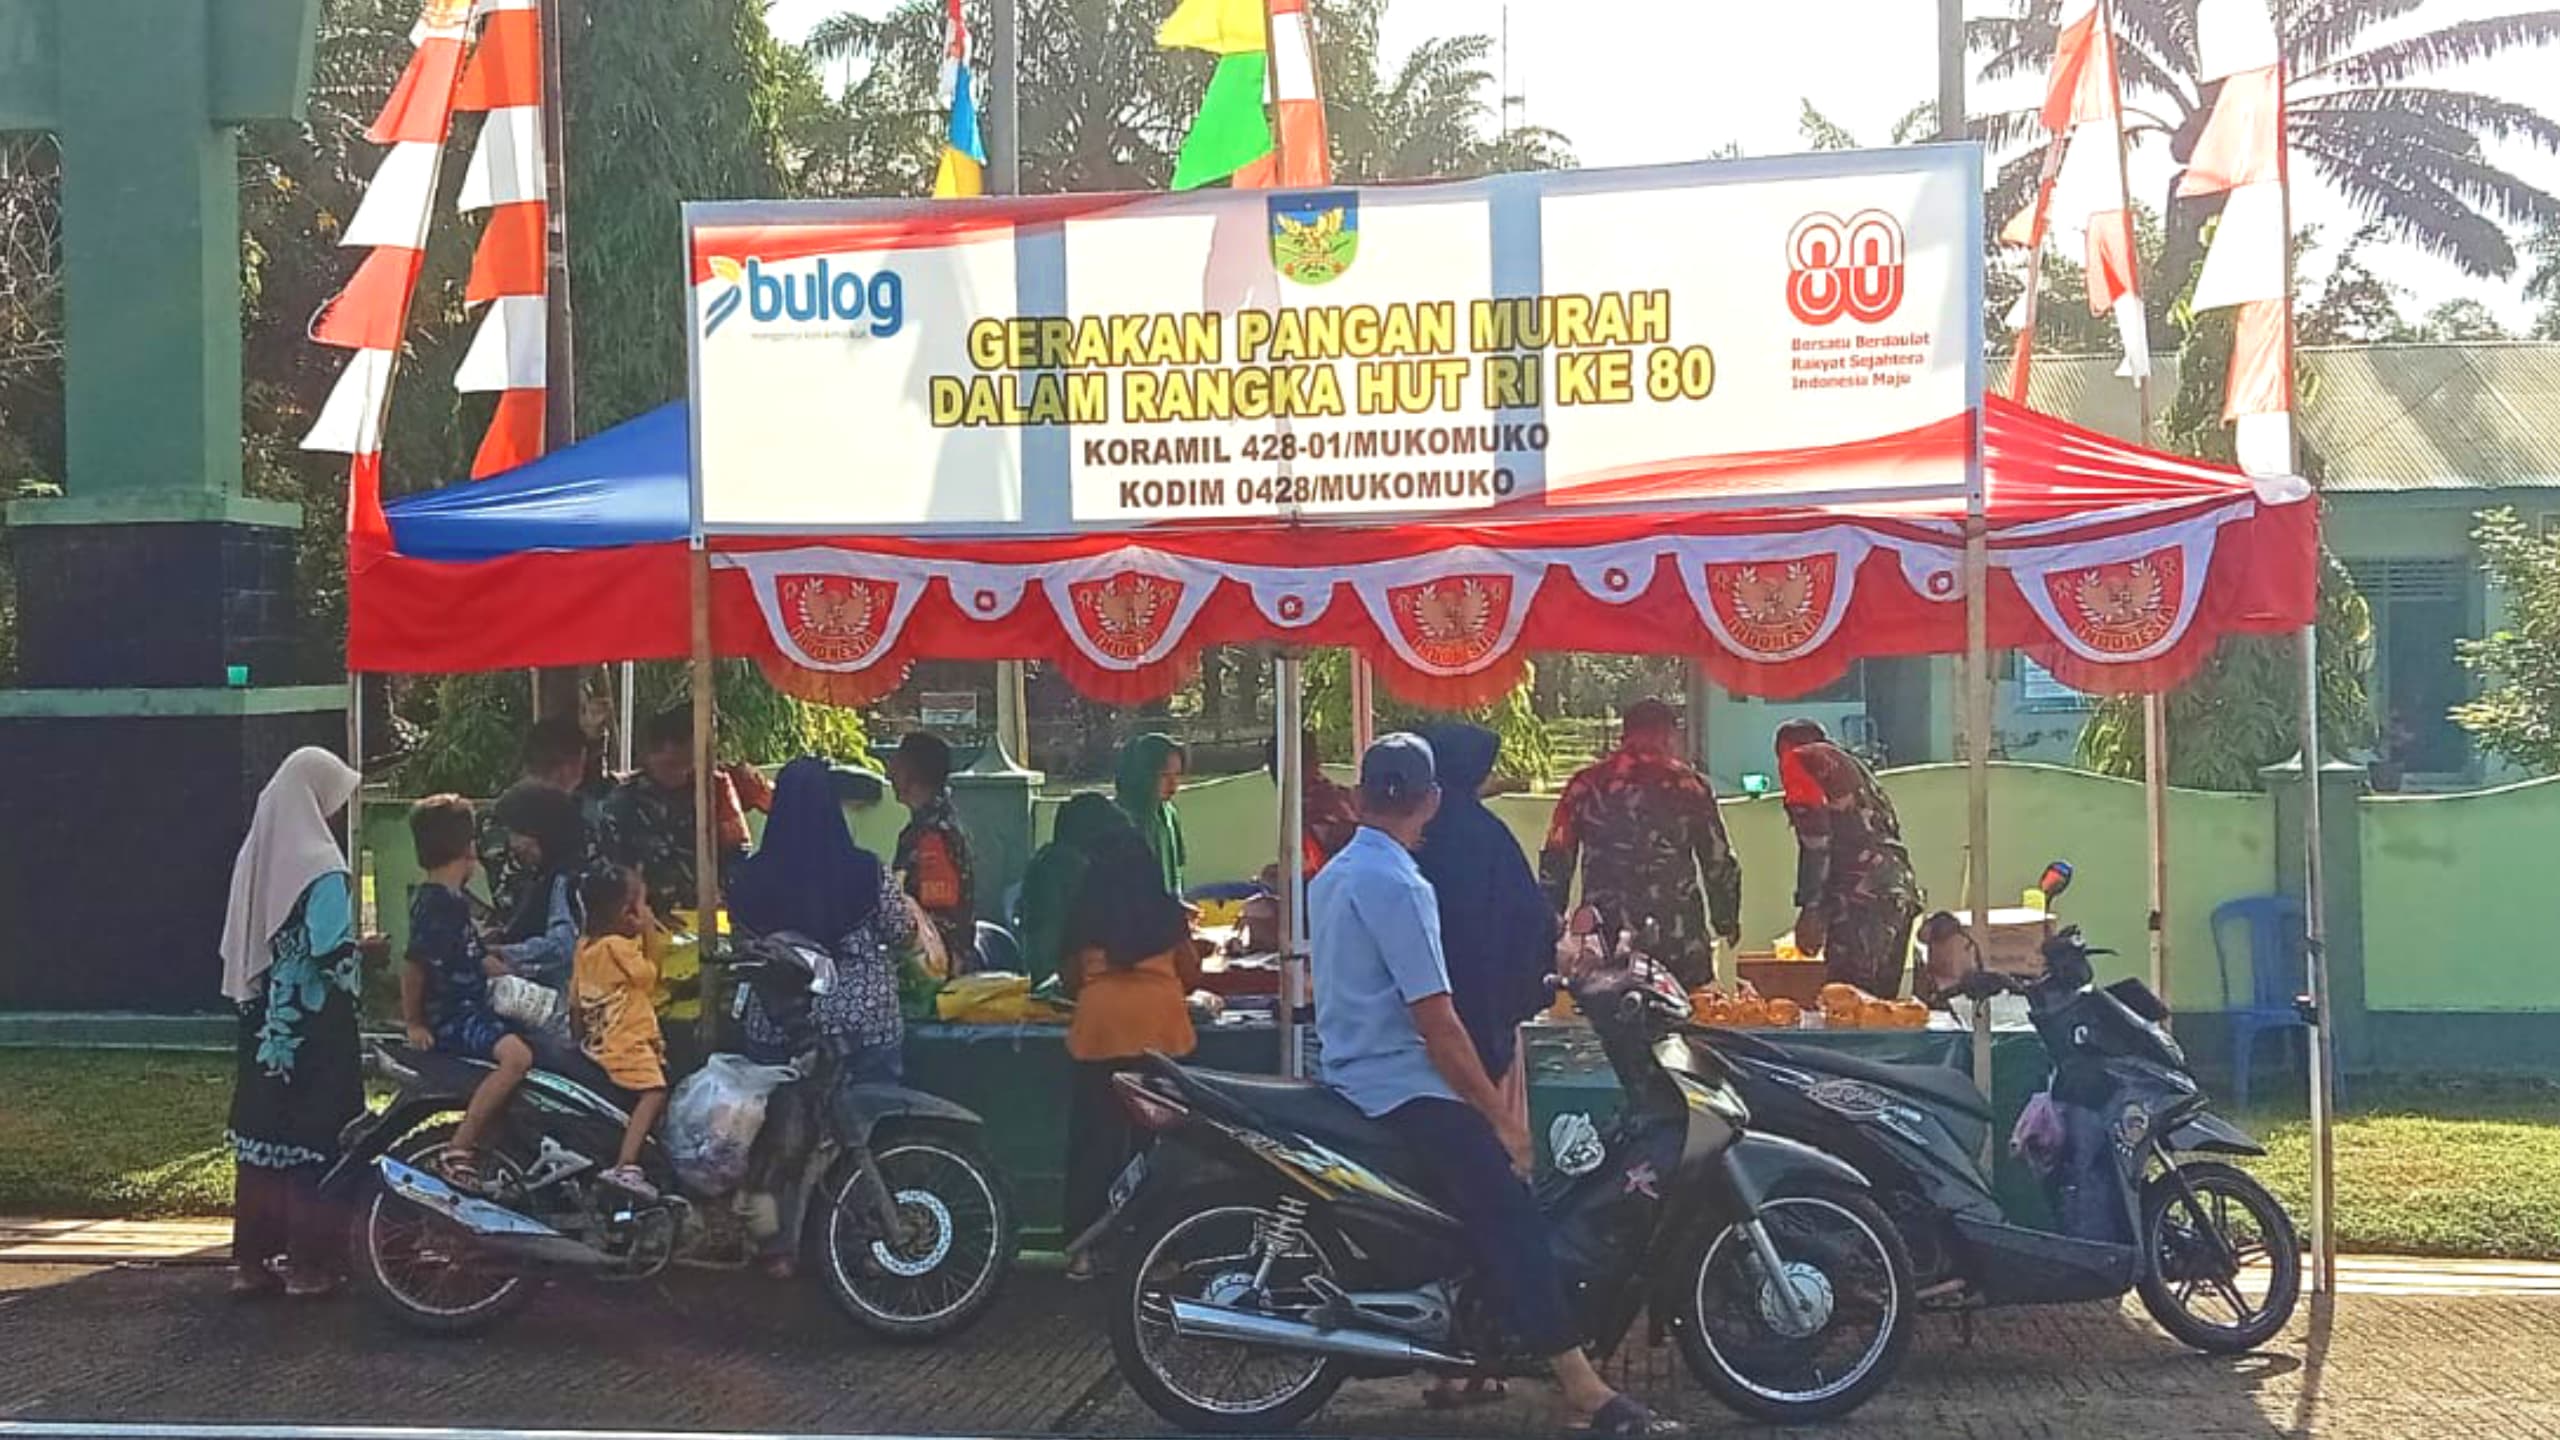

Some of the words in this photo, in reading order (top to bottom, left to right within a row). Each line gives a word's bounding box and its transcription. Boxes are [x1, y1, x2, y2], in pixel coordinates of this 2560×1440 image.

[1786, 208, 1904, 326] 80
[748, 257, 904, 337] bulog
[967, 313, 1222, 372] GERAKAN
[1237, 303, 1455, 362] PANGAN
[1470, 290, 1671, 352] MURAH
[1792, 337, 1851, 351] Bersatu
[1855, 331, 1931, 348] Berdaulat
[1792, 357, 1846, 372] Rakyat
[1849, 352, 1924, 369] Sejahtera
[1792, 376, 1869, 390] Indonesia
[1872, 372, 1911, 388] Maju
[930, 373, 1108, 427] DALAM
[1123, 363, 1344, 422] RANGKA
[1358, 358, 1468, 413] HUT
[1484, 354, 1541, 408] RI
[1557, 349, 1634, 403] KE
[1648, 345, 1715, 399] 80
[1084, 435, 1231, 466] KORAMIL
[1241, 424, 1550, 462] 428-01/MUKOMUKO
[1119, 479, 1226, 509] KODIM
[1236, 467, 1514, 508] 0428/MUKOMUKO
[1727, 609, 1821, 650] INDONESIA
[2074, 606, 2176, 651] INDONESIA
